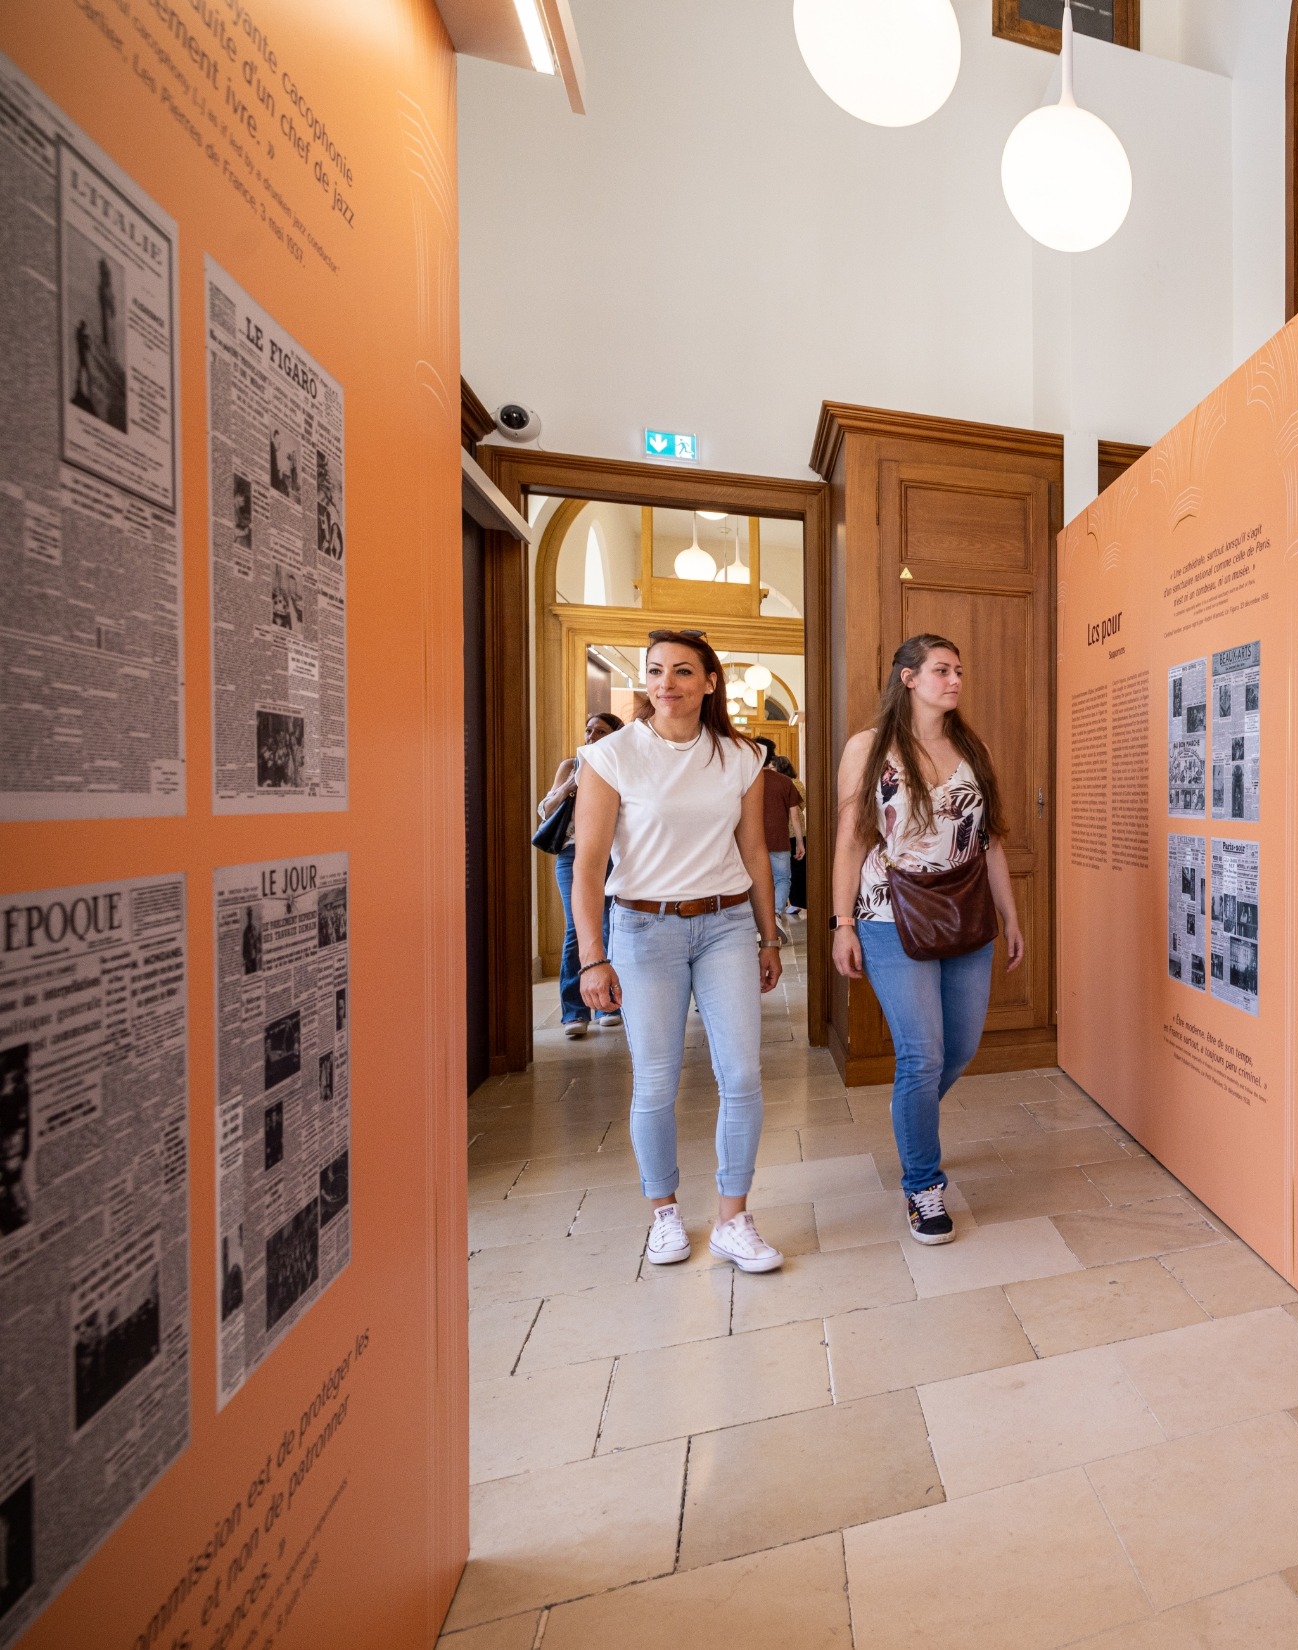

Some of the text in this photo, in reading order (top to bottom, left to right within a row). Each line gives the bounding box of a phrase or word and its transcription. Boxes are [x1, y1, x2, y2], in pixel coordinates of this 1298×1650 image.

[148, 0, 219, 90] ement
[226, 77, 260, 145] ivre.
[242, 60, 275, 117] d'un
[280, 114, 310, 164] chef
[314, 160, 330, 193] de
[332, 182, 354, 229] jazz
[282, 72, 353, 187] cacophonie
[245, 317, 318, 400] LE FIGARO
[1088, 612, 1122, 646] Les pour
[262, 865, 317, 897] LE JOUR
[1223, 842, 1245, 851] Paris-soir
[1164, 1024, 1168, 1032] en
[1169, 1025, 1182, 1040] France
[1184, 1036, 1199, 1052] surtout,
[1205, 1046, 1225, 1065] toujours
[1225, 1060, 1237, 1072] paru
[1239, 1068, 1261, 1087] criminel.
[1207, 1032, 1216, 1045] être
[1218, 1038, 1223, 1049] de
[1225, 1045, 1234, 1055] son
[1236, 1049, 1253, 1067] temps,
[247, 1455, 271, 1509] est
[277, 1429, 295, 1468] de
[299, 1350, 352, 1448] protéger
[355, 1328, 369, 1360] les
[201, 1394, 349, 1627] et non de patronner
